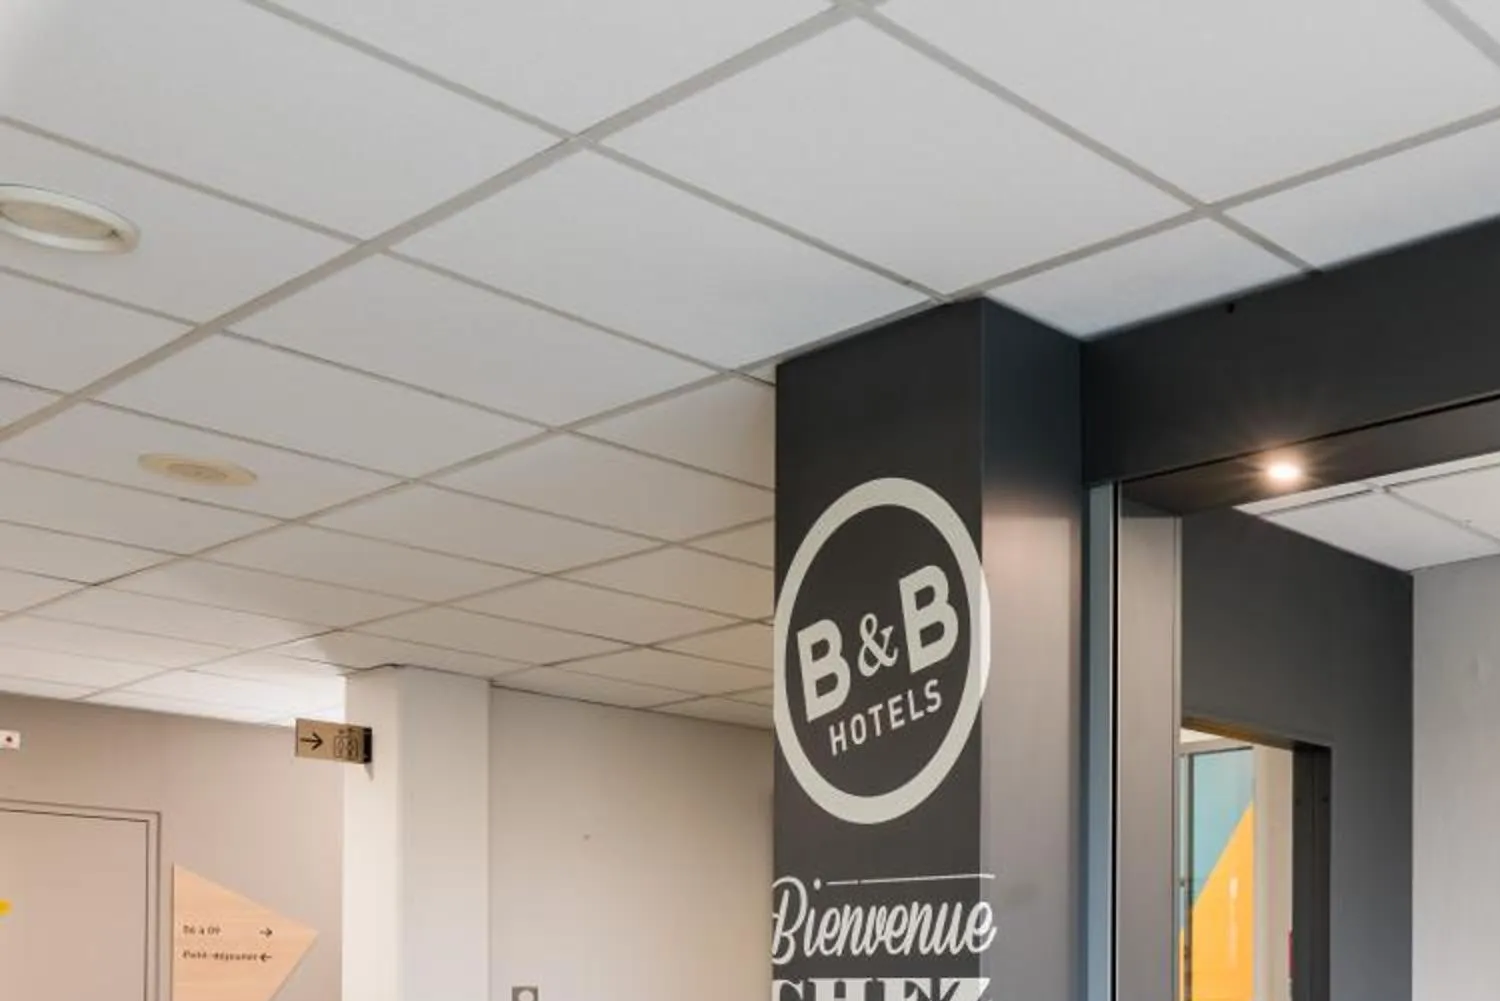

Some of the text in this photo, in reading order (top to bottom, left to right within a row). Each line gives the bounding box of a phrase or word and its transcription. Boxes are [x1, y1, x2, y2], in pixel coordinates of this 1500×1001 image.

[798, 565, 958, 722] B&B
[829, 679, 942, 756] HOTELS
[772, 876, 997, 965] Bienvenue
